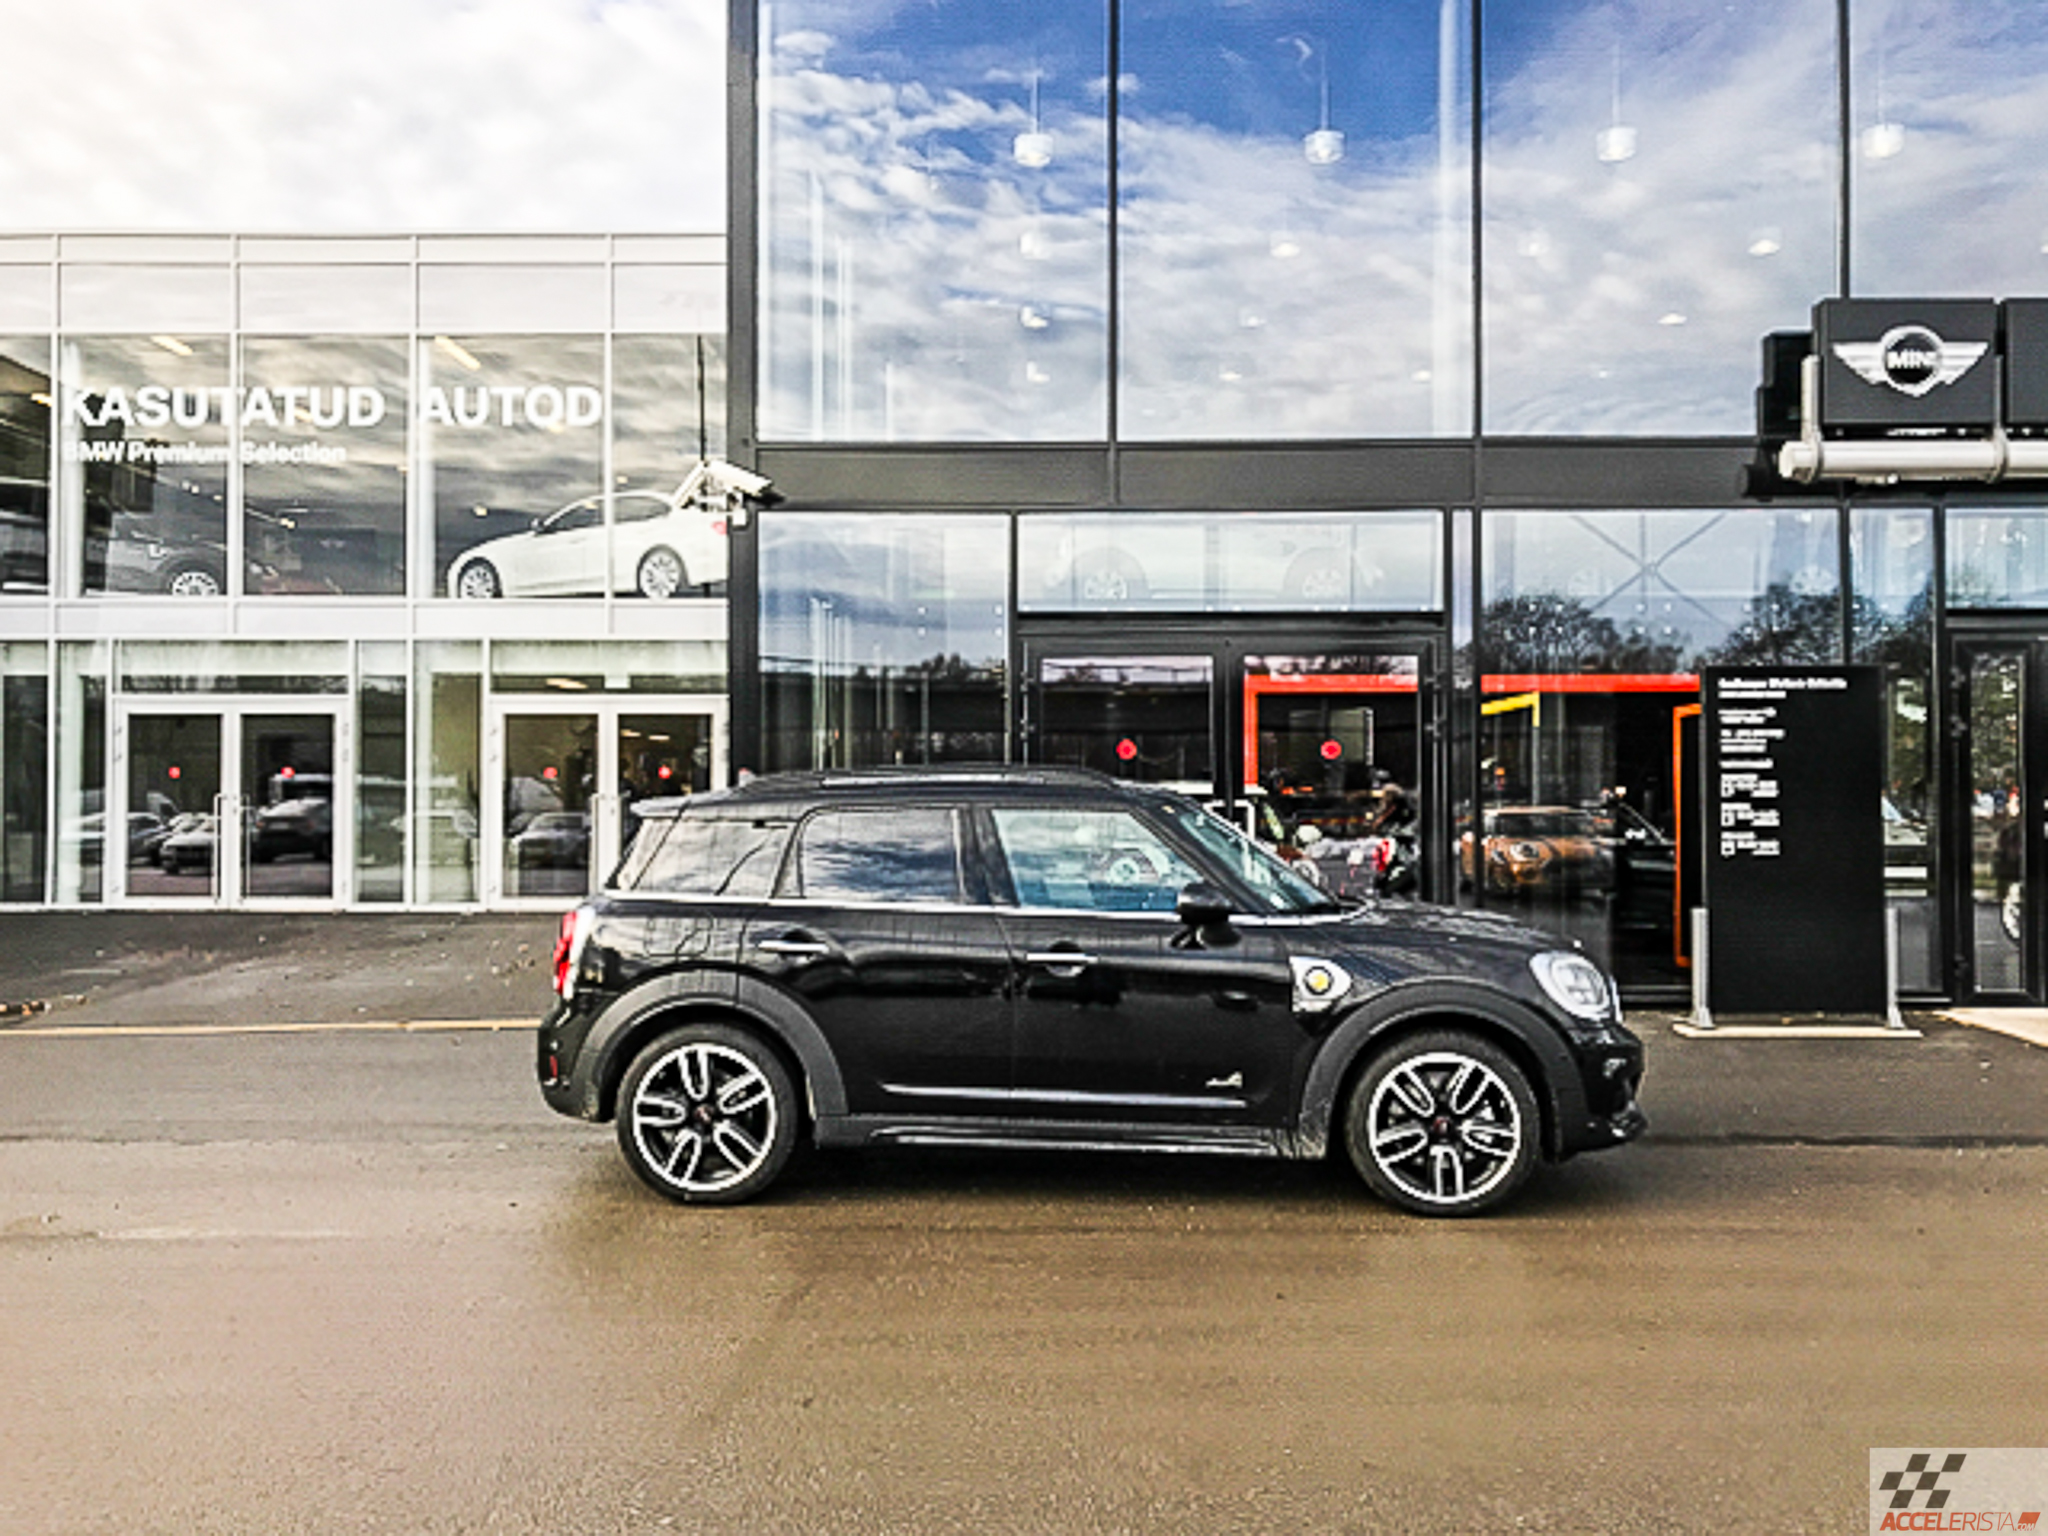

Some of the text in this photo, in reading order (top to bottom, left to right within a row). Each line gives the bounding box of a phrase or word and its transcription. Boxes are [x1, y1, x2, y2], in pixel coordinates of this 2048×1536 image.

[63, 386, 602, 428] KASUTATUD AUTOD
[64, 440, 347, 462] BMW Premium Selection
